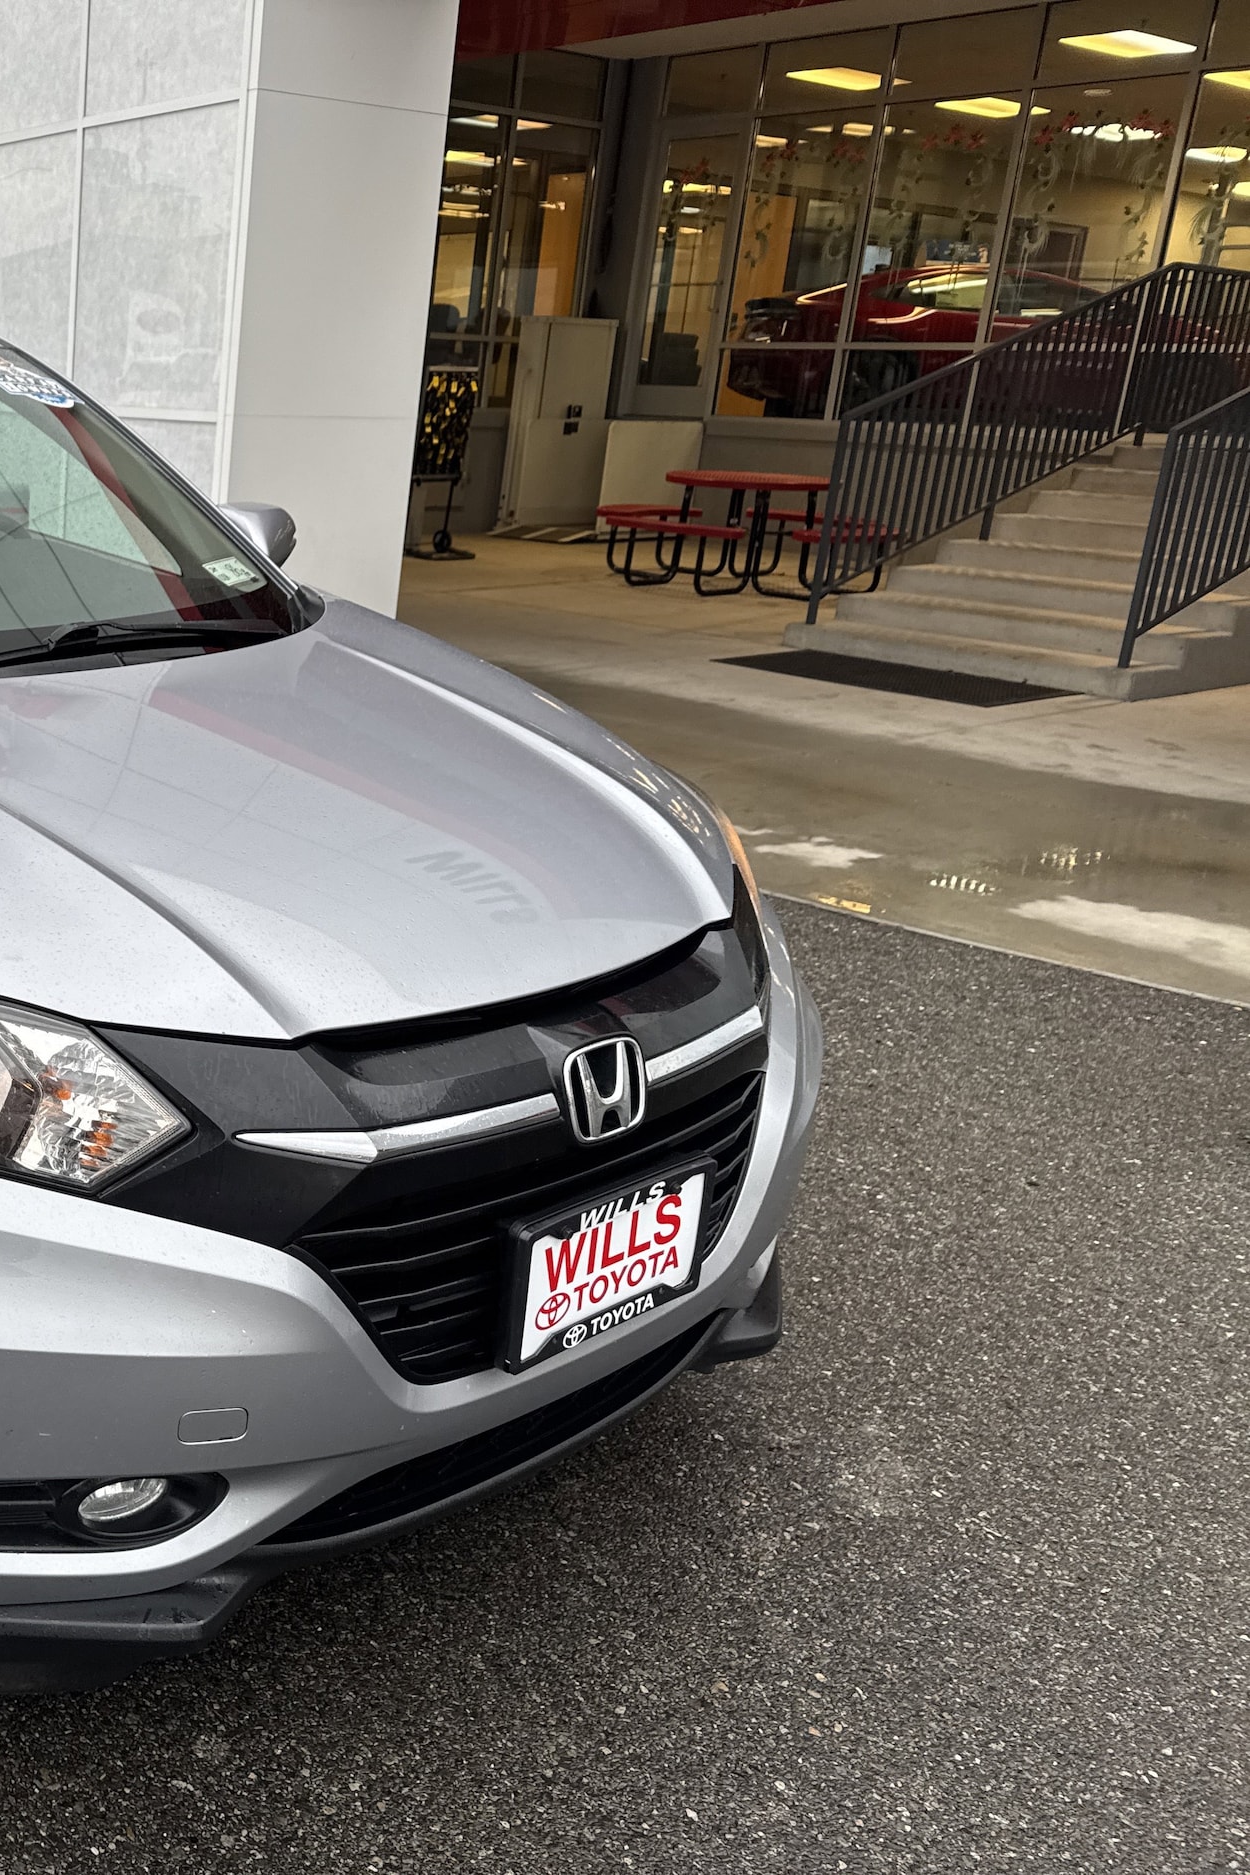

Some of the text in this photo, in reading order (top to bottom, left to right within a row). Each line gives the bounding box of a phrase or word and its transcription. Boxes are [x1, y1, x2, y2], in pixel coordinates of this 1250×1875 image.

[580, 1181, 666, 1231] WILLS
[545, 1194, 682, 1292] WILLS
[574, 1245, 679, 1311] TOYOTA
[590, 1293, 654, 1335] TOYOTA
